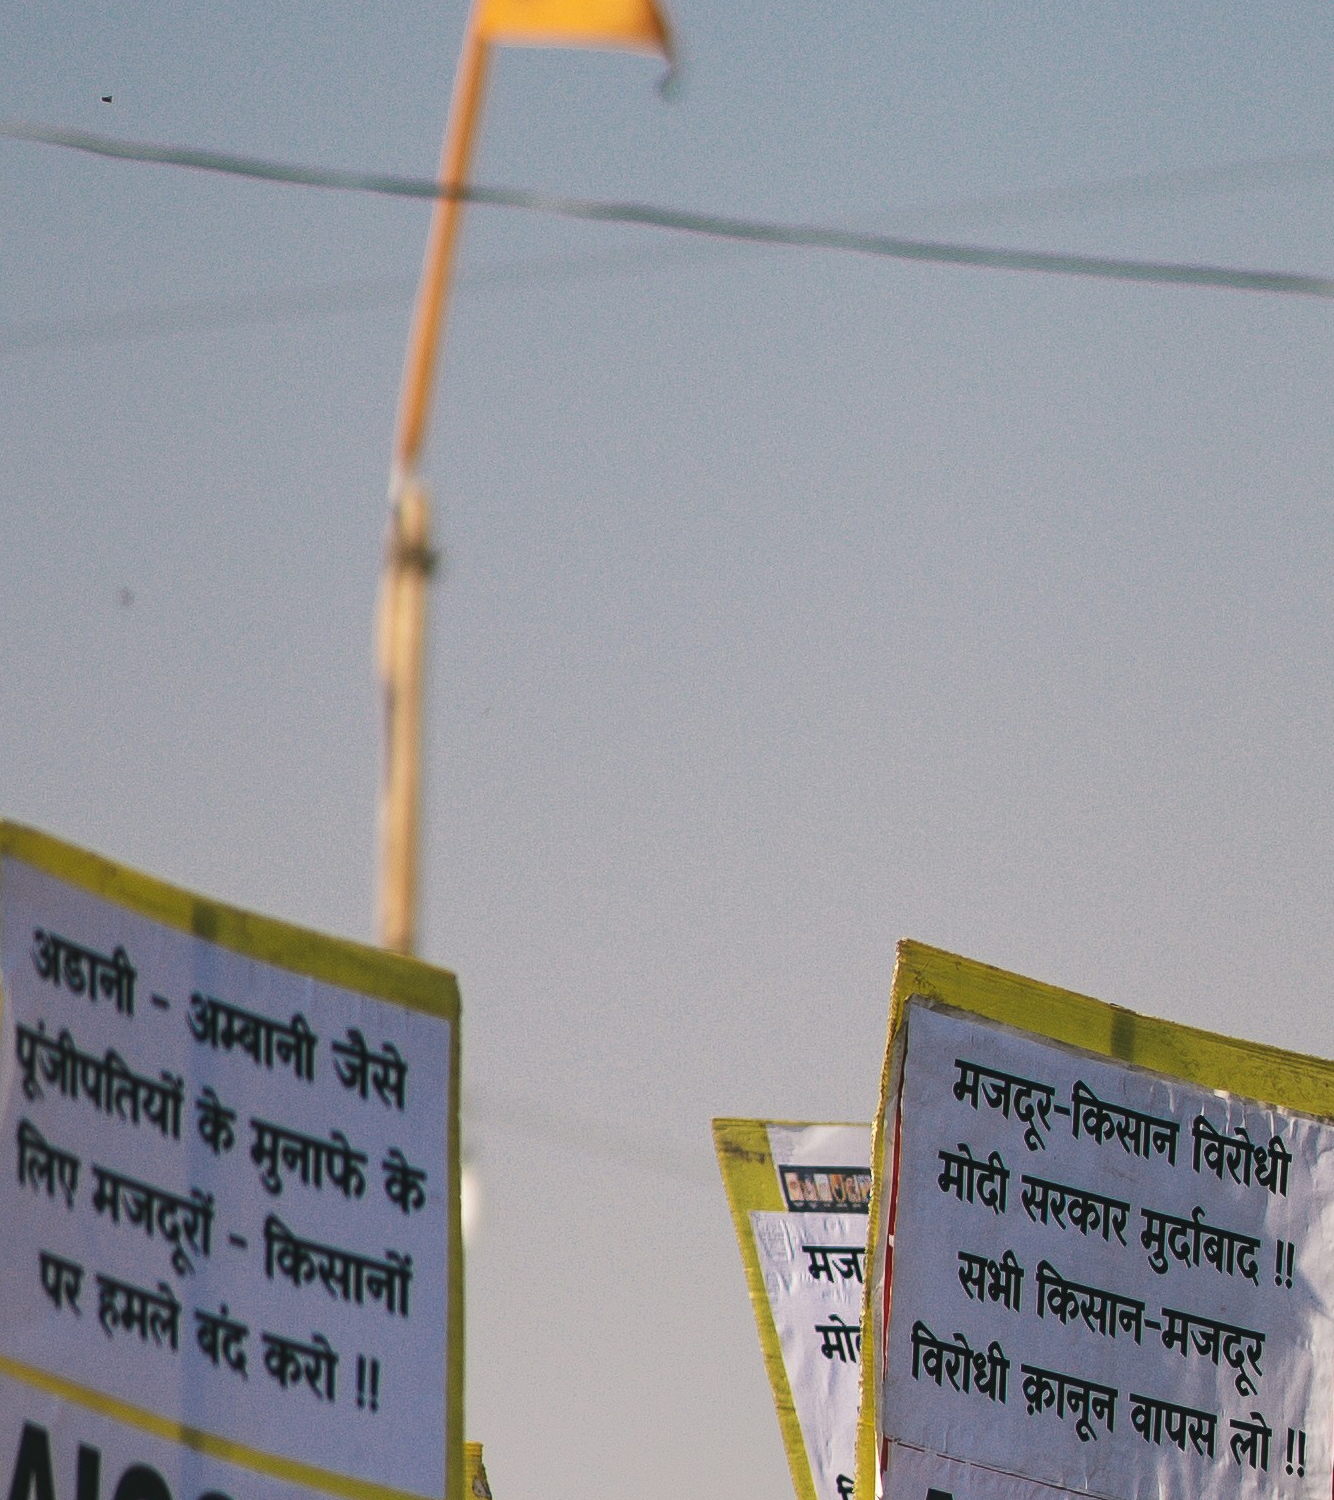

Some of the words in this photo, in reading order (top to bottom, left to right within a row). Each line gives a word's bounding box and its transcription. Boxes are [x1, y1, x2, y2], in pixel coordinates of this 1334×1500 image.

[31, 926, 136, 1018] अडानी
[187, 991, 316, 1082] अम्बानी
[331, 1025, 408, 1111] जैसे
[16, 1018, 184, 1141] पूंजीपतियों
[195, 1085, 236, 1155] के
[250, 1117, 367, 1199] मुनाफे
[382, 1146, 428, 1215] के
[953, 1058, 1180, 1165] मजदूर-किसान
[1192, 1115, 1292, 1197] विरोधी
[16, 1116, 80, 1208] लिए
[92, 1163, 215, 1277] मजदूरों
[263, 1212, 413, 1318] किसानों
[937, 1144, 1010, 1215] मोदी
[1021, 1174, 1130, 1247] सरकार
[1140, 1207, 1260, 1285] मुर्दाबाद
[1274, 1239, 1295, 1289] !!
[39, 1250, 84, 1317] पर
[94, 1272, 182, 1352] हमले
[194, 1303, 249, 1380] बंद
[261, 1330, 339, 1402] करो
[356, 1353, 381, 1412] !!
[911, 1320, 1010, 1404] विरोधी
[1129, 1392, 1217, 1458] वापस
[1229, 1412, 1272, 1472] लो
[1285, 1428, 1306, 1478] !!
[957, 1249, 1023, 1311] सभी
[1036, 1260, 1265, 1396] किसान-मजदूर
